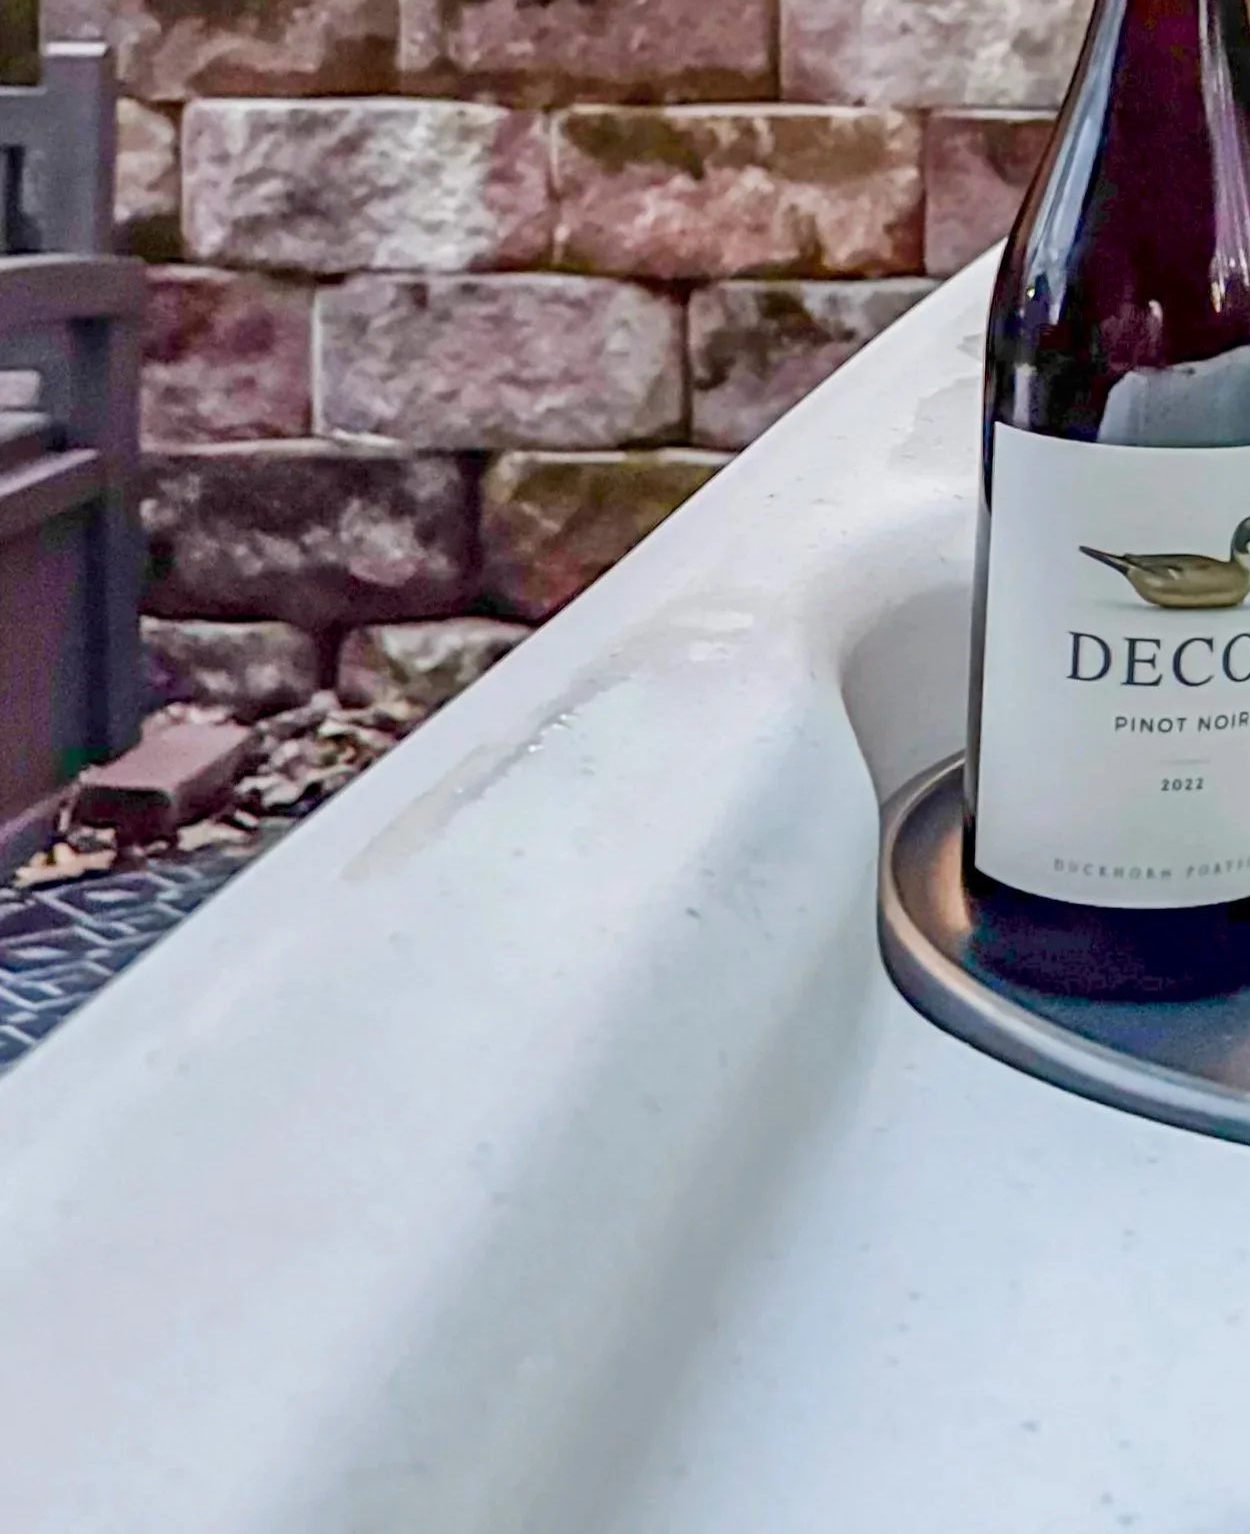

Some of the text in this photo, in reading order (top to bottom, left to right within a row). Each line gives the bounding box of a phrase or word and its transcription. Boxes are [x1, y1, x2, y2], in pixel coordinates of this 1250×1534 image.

[1114, 711, 1250, 734] PINOT NOIR
[1160, 777, 1205, 793] 2022
